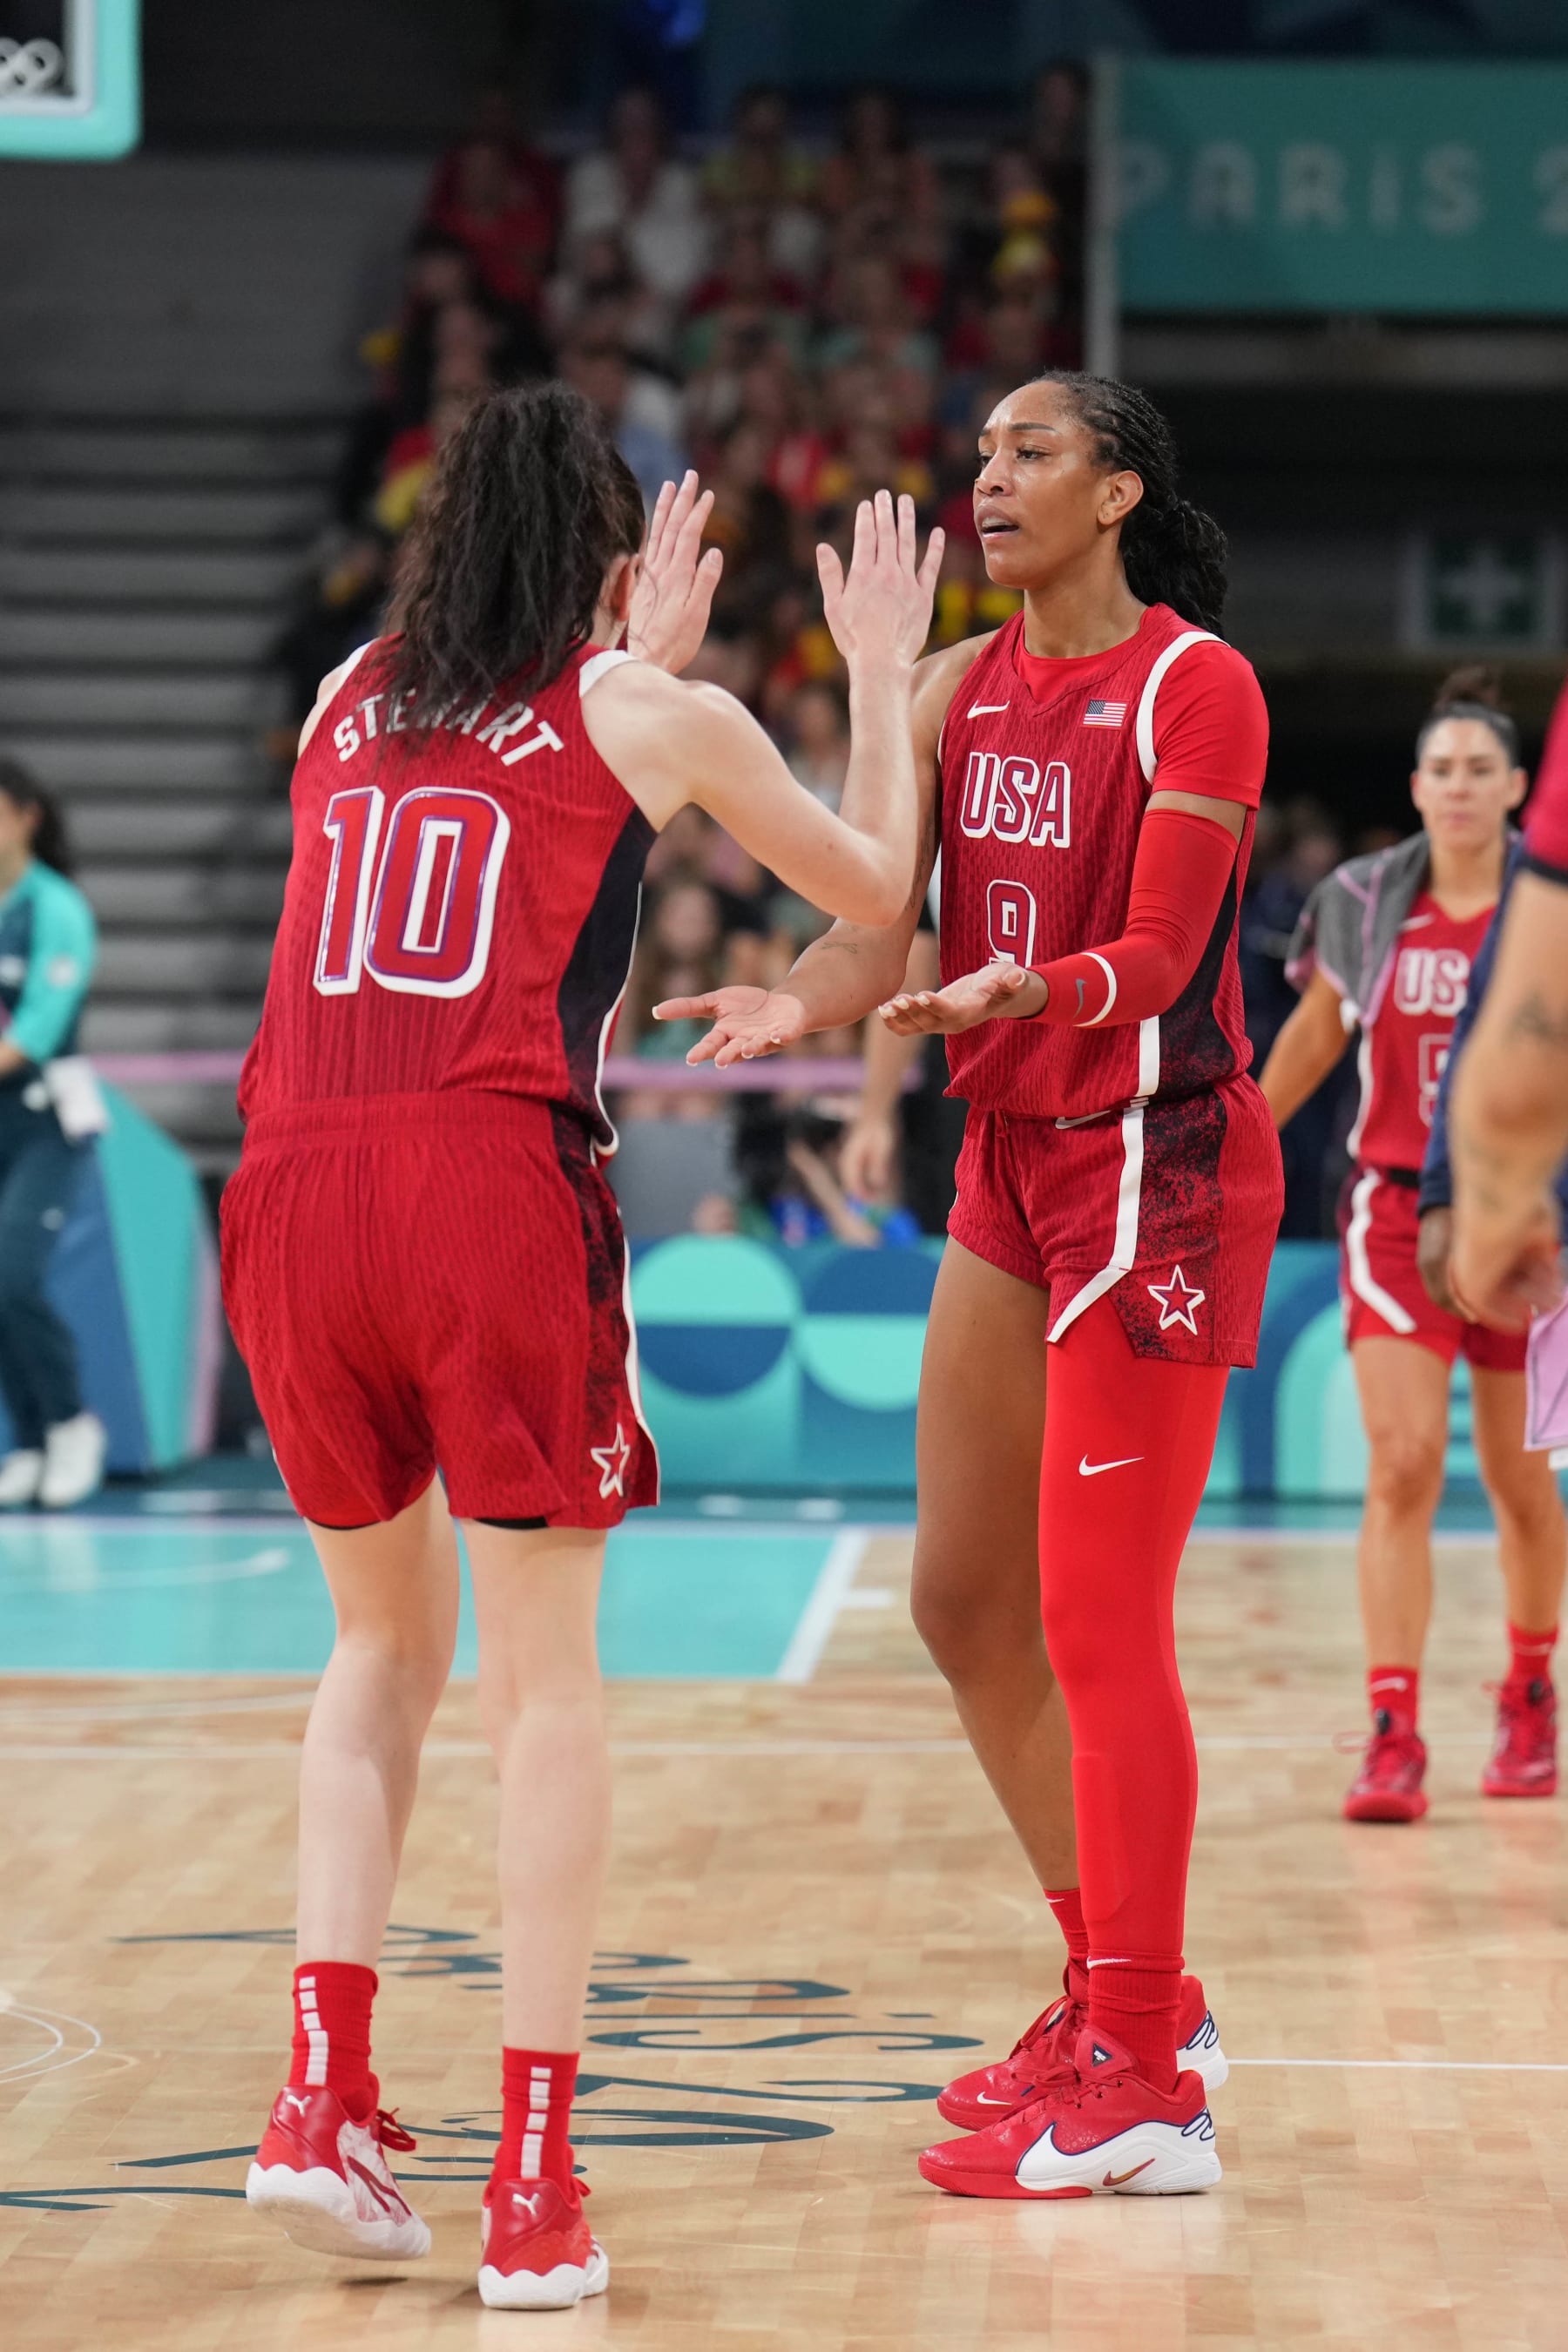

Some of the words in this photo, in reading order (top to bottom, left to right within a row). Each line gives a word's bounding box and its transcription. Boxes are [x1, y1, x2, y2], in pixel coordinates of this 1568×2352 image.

[960, 752, 1071, 848] USA
[313, 786, 510, 998] 10
[986, 879, 1037, 968] 9
[1394, 948, 1470, 1017] US
